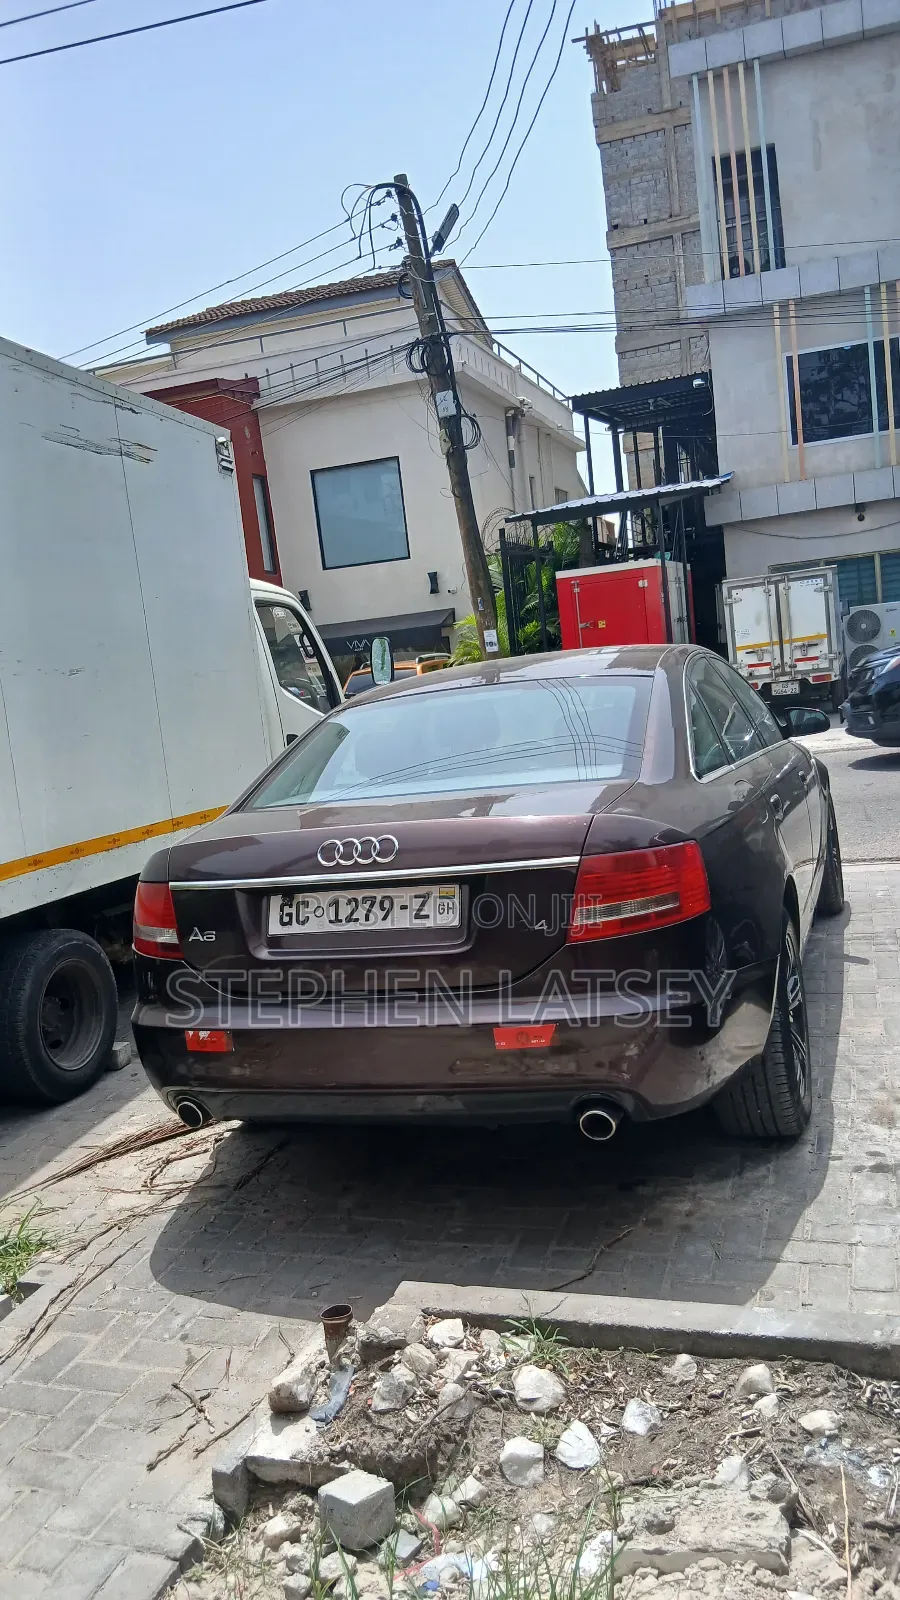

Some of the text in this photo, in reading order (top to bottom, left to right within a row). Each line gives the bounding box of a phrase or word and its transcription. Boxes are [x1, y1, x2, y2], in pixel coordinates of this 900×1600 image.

[279, 893, 431, 927] GC 1279-Z
[437, 901, 455, 916] GH
[188, 926, 216, 942] A6
